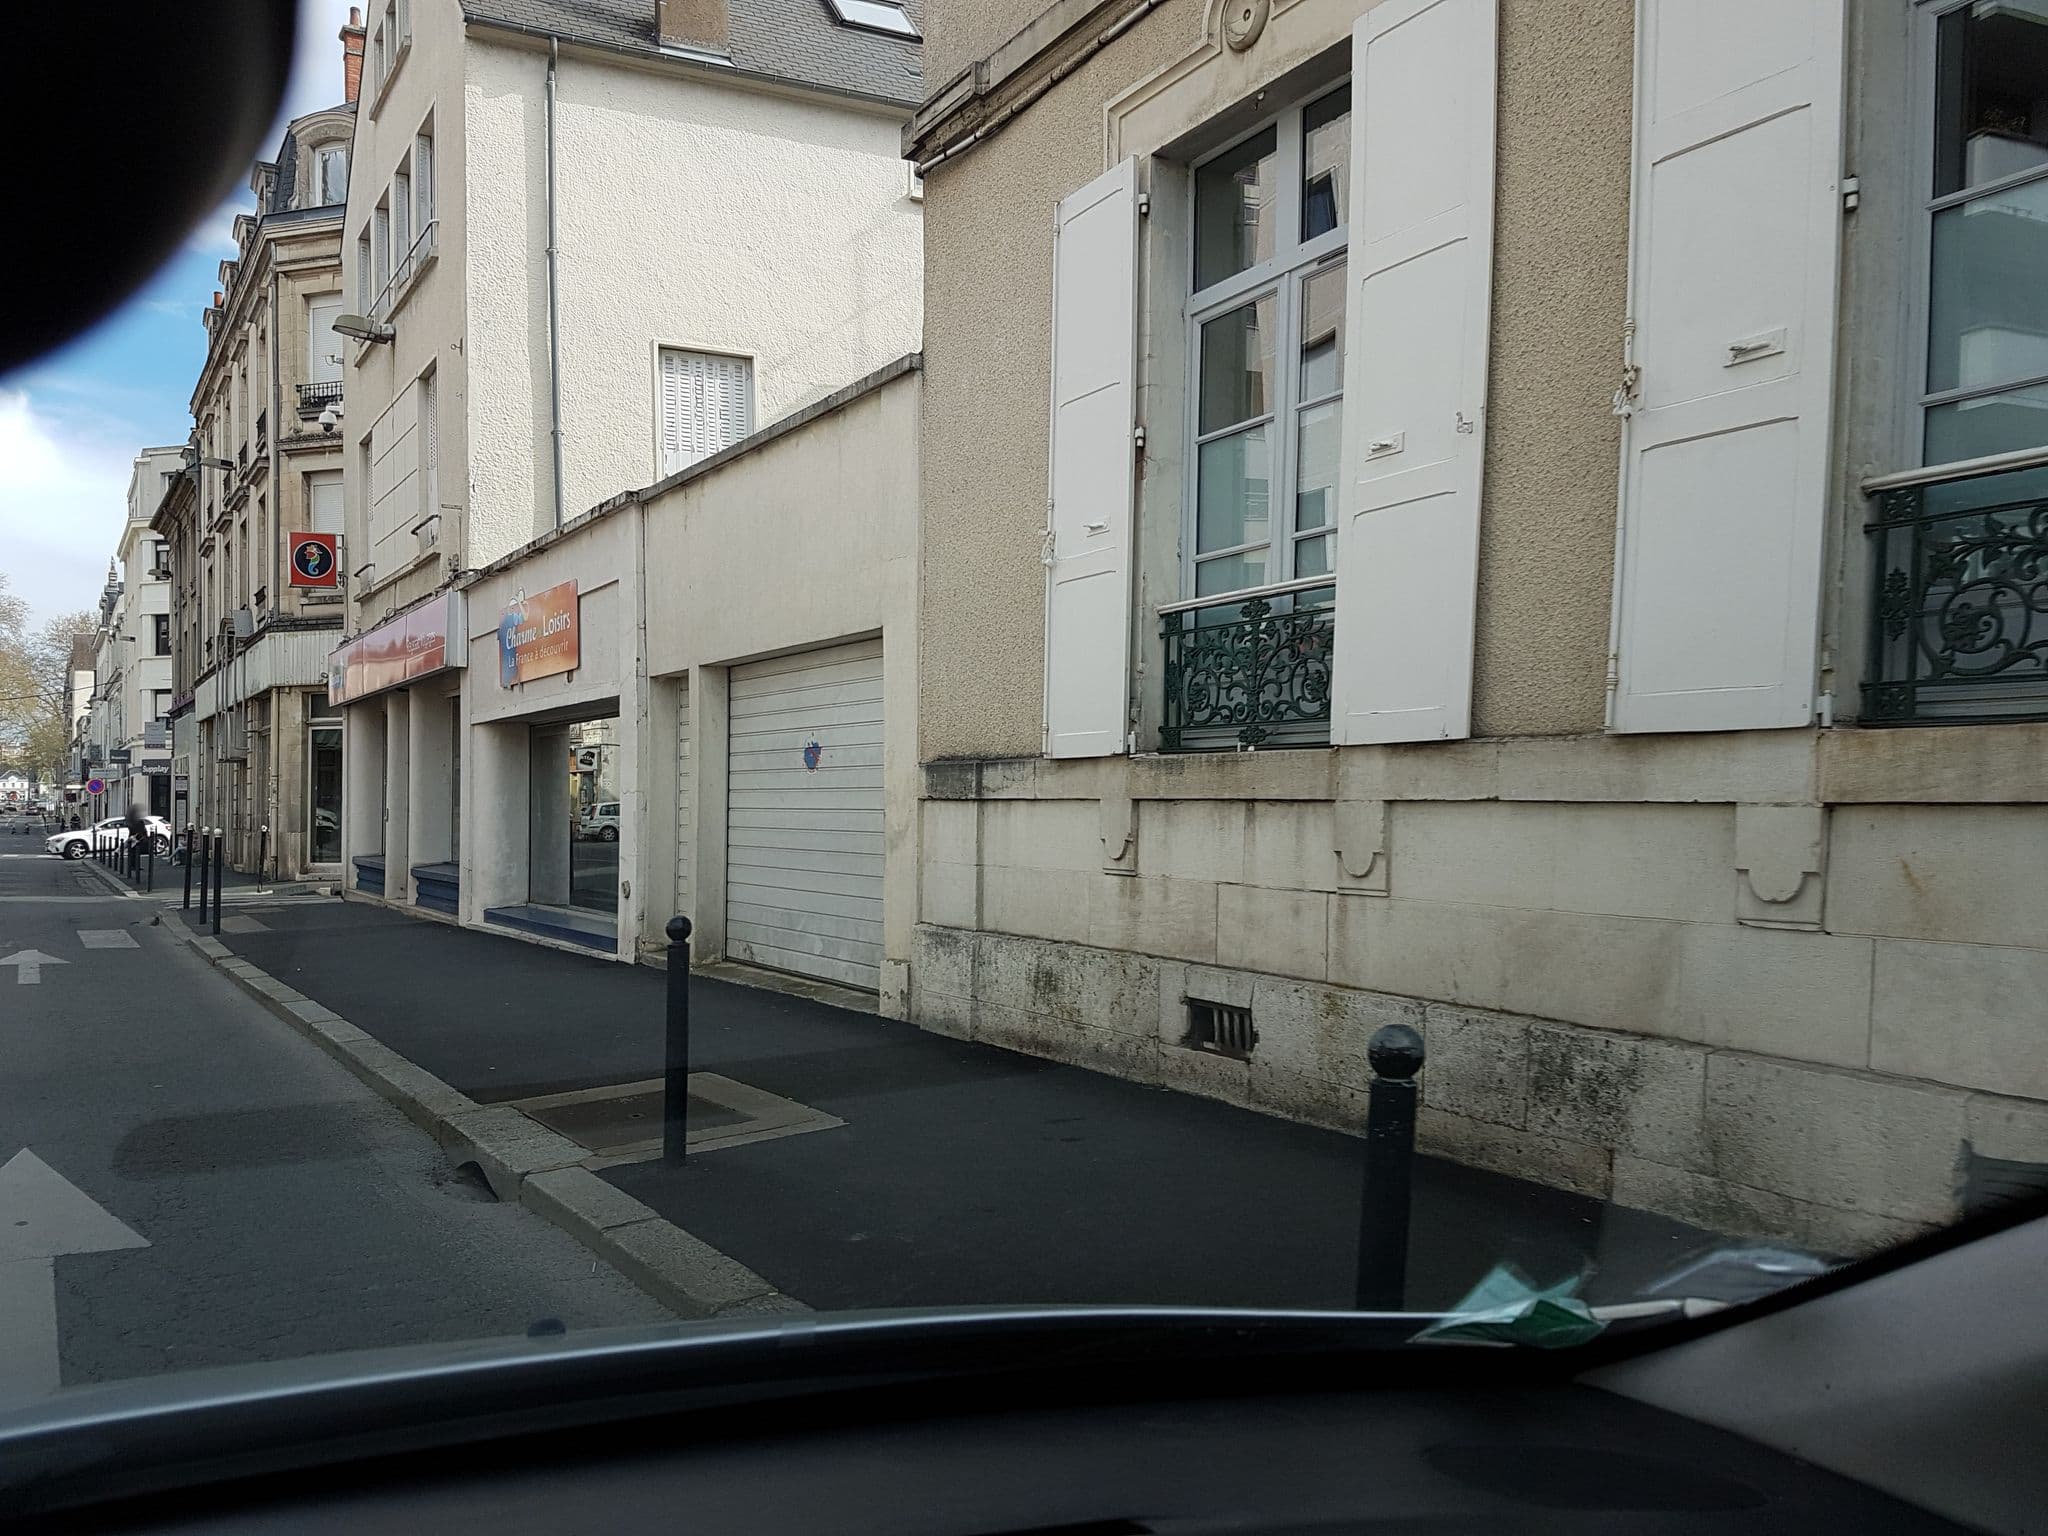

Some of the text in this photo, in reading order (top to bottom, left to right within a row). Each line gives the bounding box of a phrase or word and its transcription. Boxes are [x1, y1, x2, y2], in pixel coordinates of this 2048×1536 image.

[543, 610, 571, 636] Loisirs
[508, 655, 515, 668] La
[142, 765, 169, 774] Supplay
